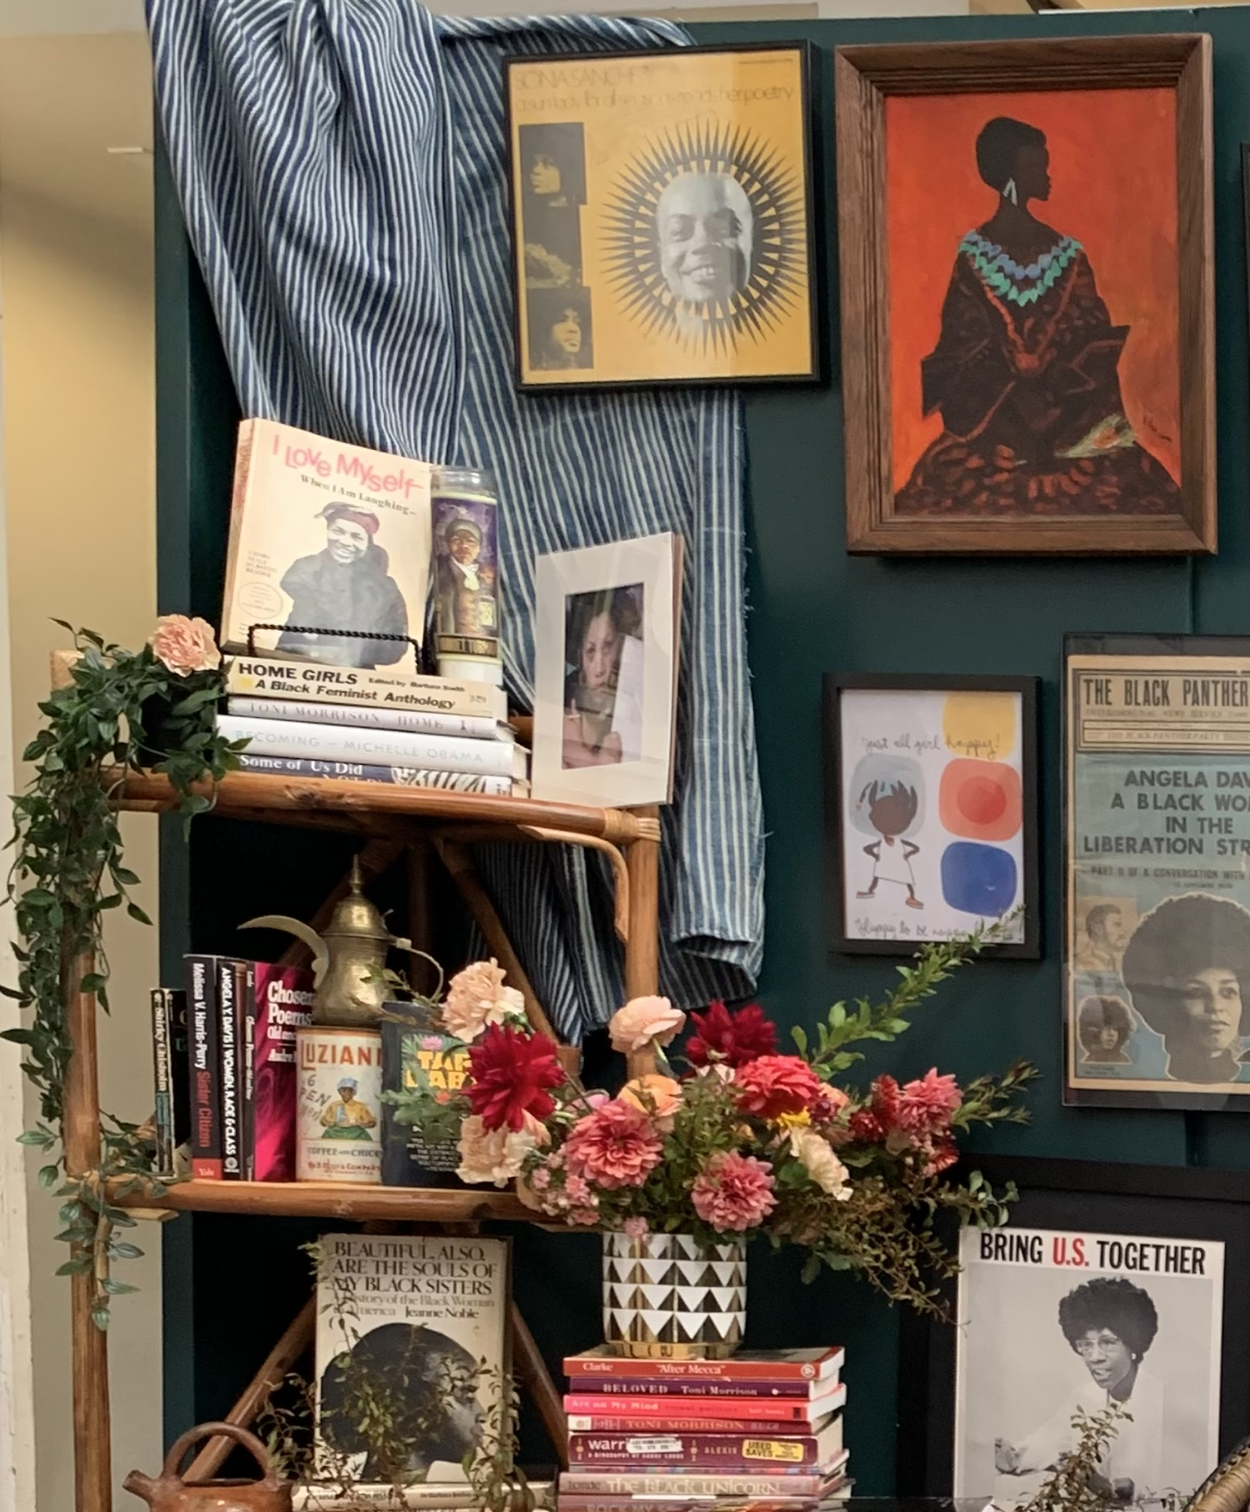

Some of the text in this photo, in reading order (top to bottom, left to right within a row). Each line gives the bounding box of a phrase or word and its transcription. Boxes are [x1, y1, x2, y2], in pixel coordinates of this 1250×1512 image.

[743, 85, 794, 106] poetry
[273, 434, 425, 499] I Myself
[301, 474, 330, 492] When
[338, 486, 357, 499] Am
[238, 662, 297, 680] HOME
[302, 668, 358, 686] GIRLS
[396, 680, 407, 688] by
[255, 679, 266, 690] A
[270, 680, 310, 695] Black
[316, 684, 378, 701] Feminist
[384, 691, 457, 711] Anthology
[1083, 678, 1249, 707] THE BLACK PANTHER
[250, 702, 444, 731] TONI MORRISON HOME
[235, 730, 484, 763] BECOMING MICHELLE OBAMA
[914, 734, 941, 756] girl
[240, 753, 363, 777] Some of Us Did
[1124, 770, 1208, 788] ANGELA
[1110, 792, 1125, 809] A
[1137, 794, 1204, 811] BLACK
[1165, 816, 1233, 834] IN THE
[1083, 836, 1204, 855] LIBERATION
[1091, 866, 1113, 876] PART
[1128, 867, 1138, 877] OF
[1143, 868, 1150, 877] A
[1153, 867, 1219, 880] CONVERSATION
[1222, 870, 1246, 880] WITH
[900, 920, 911, 937] to
[193, 963, 205, 1000] Melissa
[154, 1007, 166, 1041] Shirley
[268, 1003, 312, 1026] Poems
[222, 1014, 234, 1043] DAVIS
[267, 1025, 283, 1039] Old
[194, 1010, 208, 1070] Harris-Perry
[155, 1042, 169, 1092] Chisholm
[197, 1070, 212, 1108] Sister
[224, 1091, 236, 1117] RACE
[198, 1109, 213, 1148] Citizen
[225, 1127, 237, 1155] CLASS
[307, 1147, 338, 1156] COFFEE
[980, 1232, 1206, 1275] BRING U.S. TOGETHER
[332, 1259, 498, 1278] ARE THE SOULS OF
[365, 1277, 422, 1293] BLACK
[426, 1279, 493, 1295] SISTERS
[401, 1294, 418, 1305] the
[420, 1294, 450, 1306] Black
[451, 1296, 495, 1307] Woman
[405, 1306, 479, 1319] Jeanne Noble
[583, 1363, 726, 1374] Clarke "After Mecca"
[603, 1384, 757, 1396] BELOVED Toni Morrison
[611, 1402, 626, 1410] My
[631, 1402, 658, 1410] Mind
[626, 1420, 661, 1430] TONI
[667, 1420, 745, 1430] MORRISON
[705, 1446, 737, 1455] ALEXIS
[746, 1449, 773, 1458] SAVES
[748, 1442, 772, 1450] USED
[645, 1478, 698, 1494] BLACK
